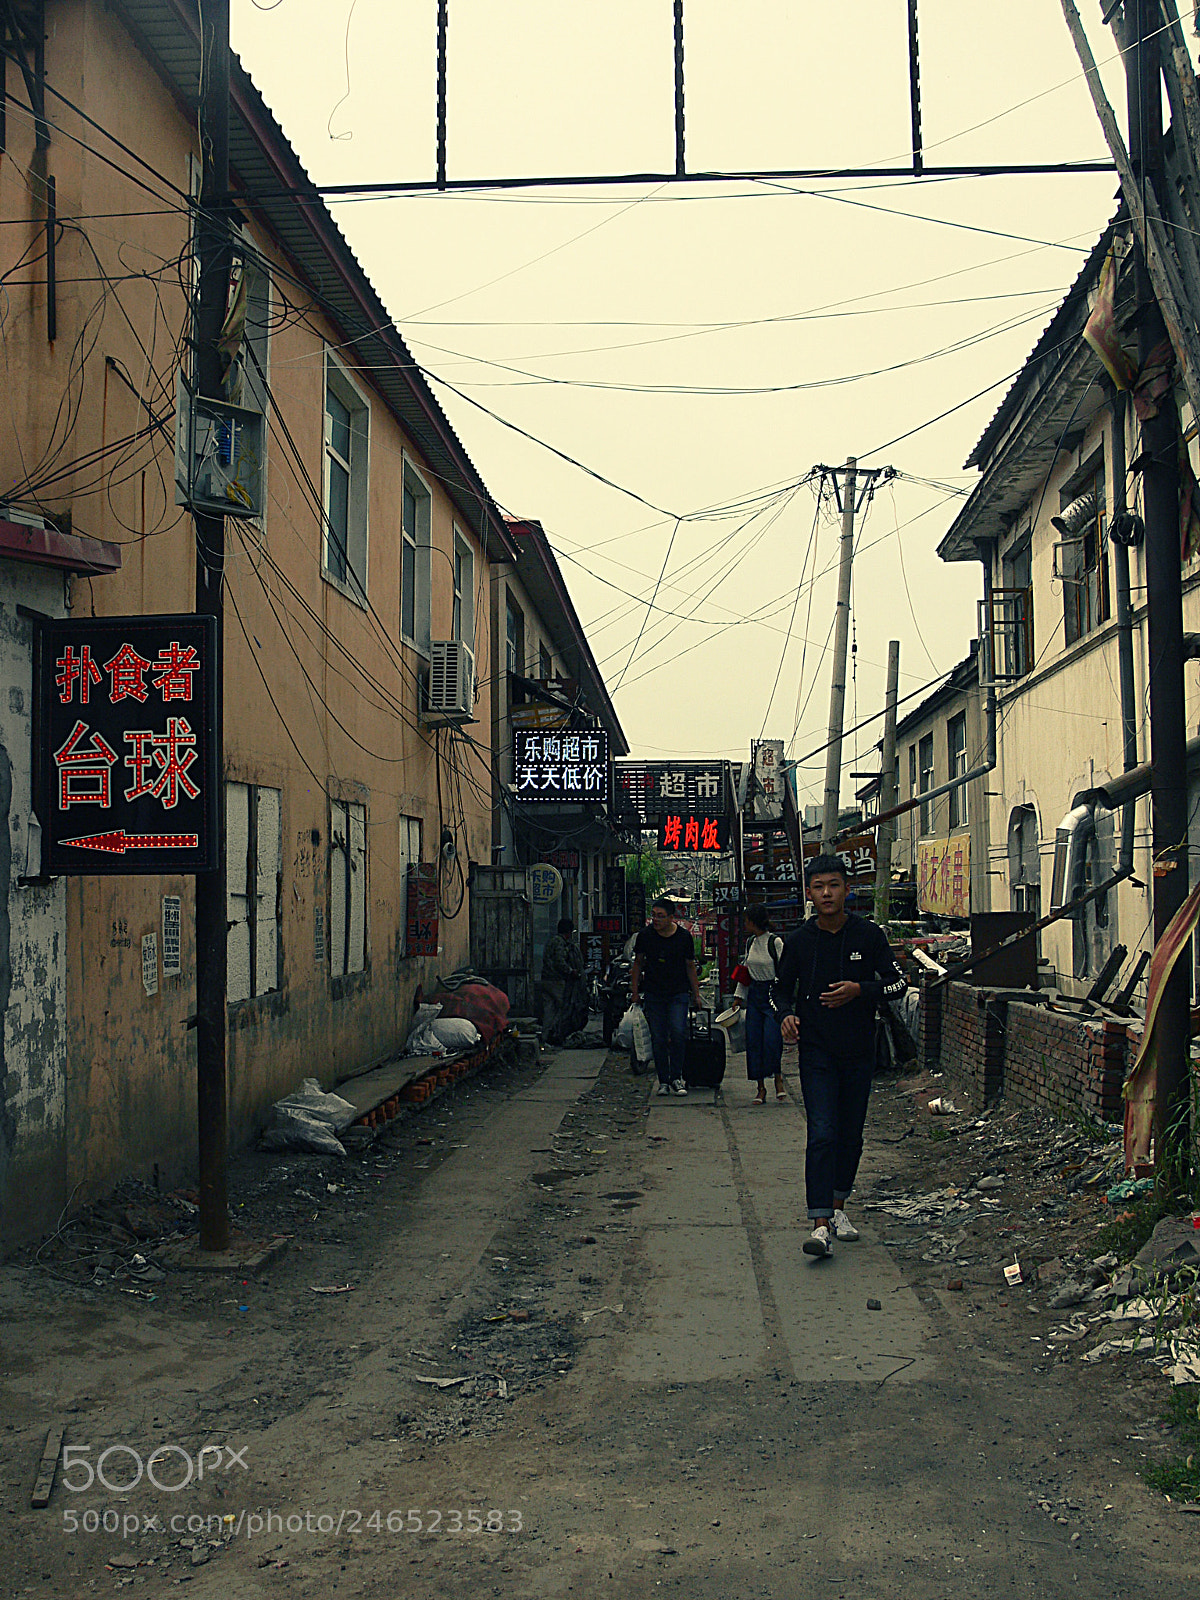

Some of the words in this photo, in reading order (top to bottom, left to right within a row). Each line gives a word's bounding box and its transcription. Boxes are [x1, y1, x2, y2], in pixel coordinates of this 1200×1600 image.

[56, 642, 200, 704] 扑食者
[53, 717, 200, 810] 台球
[524, 735, 600, 762] 乐购超市
[519, 766, 603, 790] 天天低价
[663, 815, 721, 851] 烤肉饭
